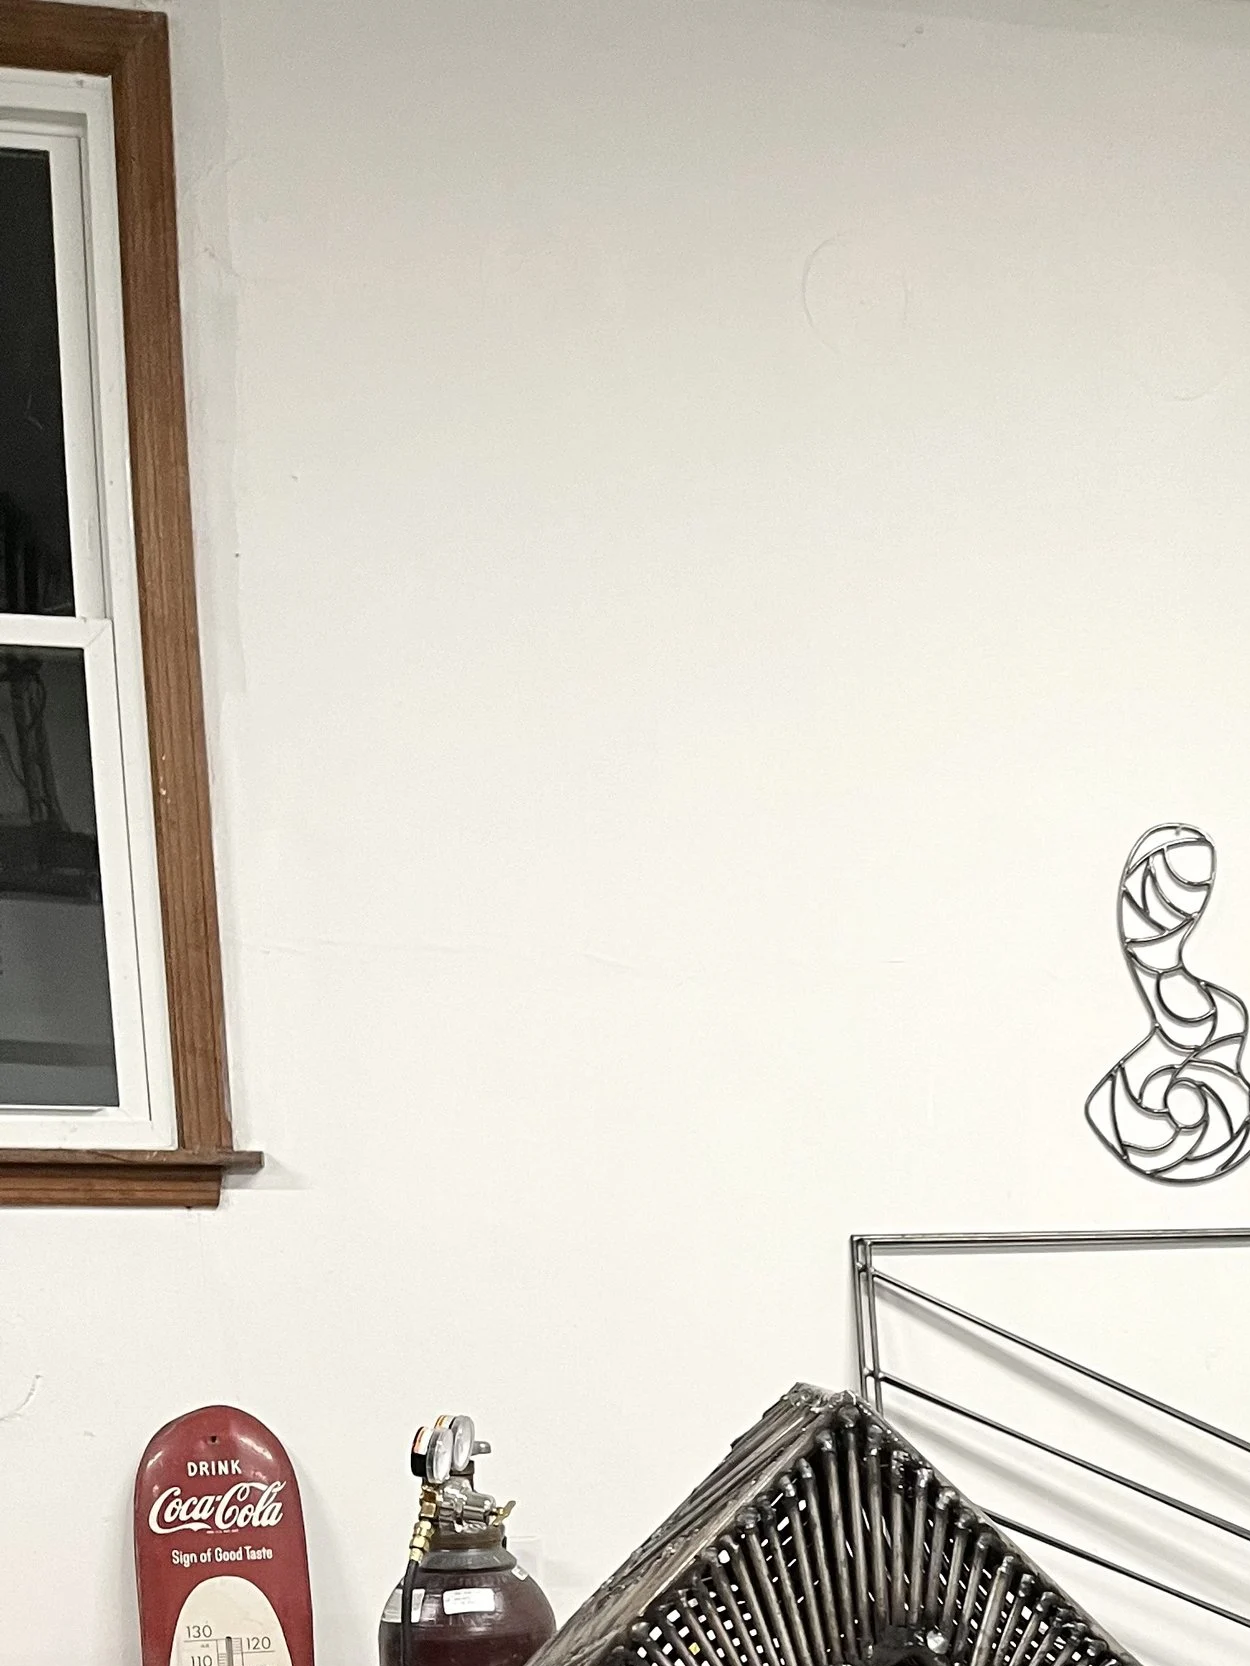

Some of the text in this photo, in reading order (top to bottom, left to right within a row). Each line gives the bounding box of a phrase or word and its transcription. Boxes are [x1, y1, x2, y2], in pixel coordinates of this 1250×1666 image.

[187, 1460, 242, 1477] DRINK
[149, 1481, 287, 1534] Coca-Cola
[171, 1545, 273, 1568] Sign of Good Taste
[187, 1625, 212, 1638] 130
[246, 1636, 271, 1650] 120
